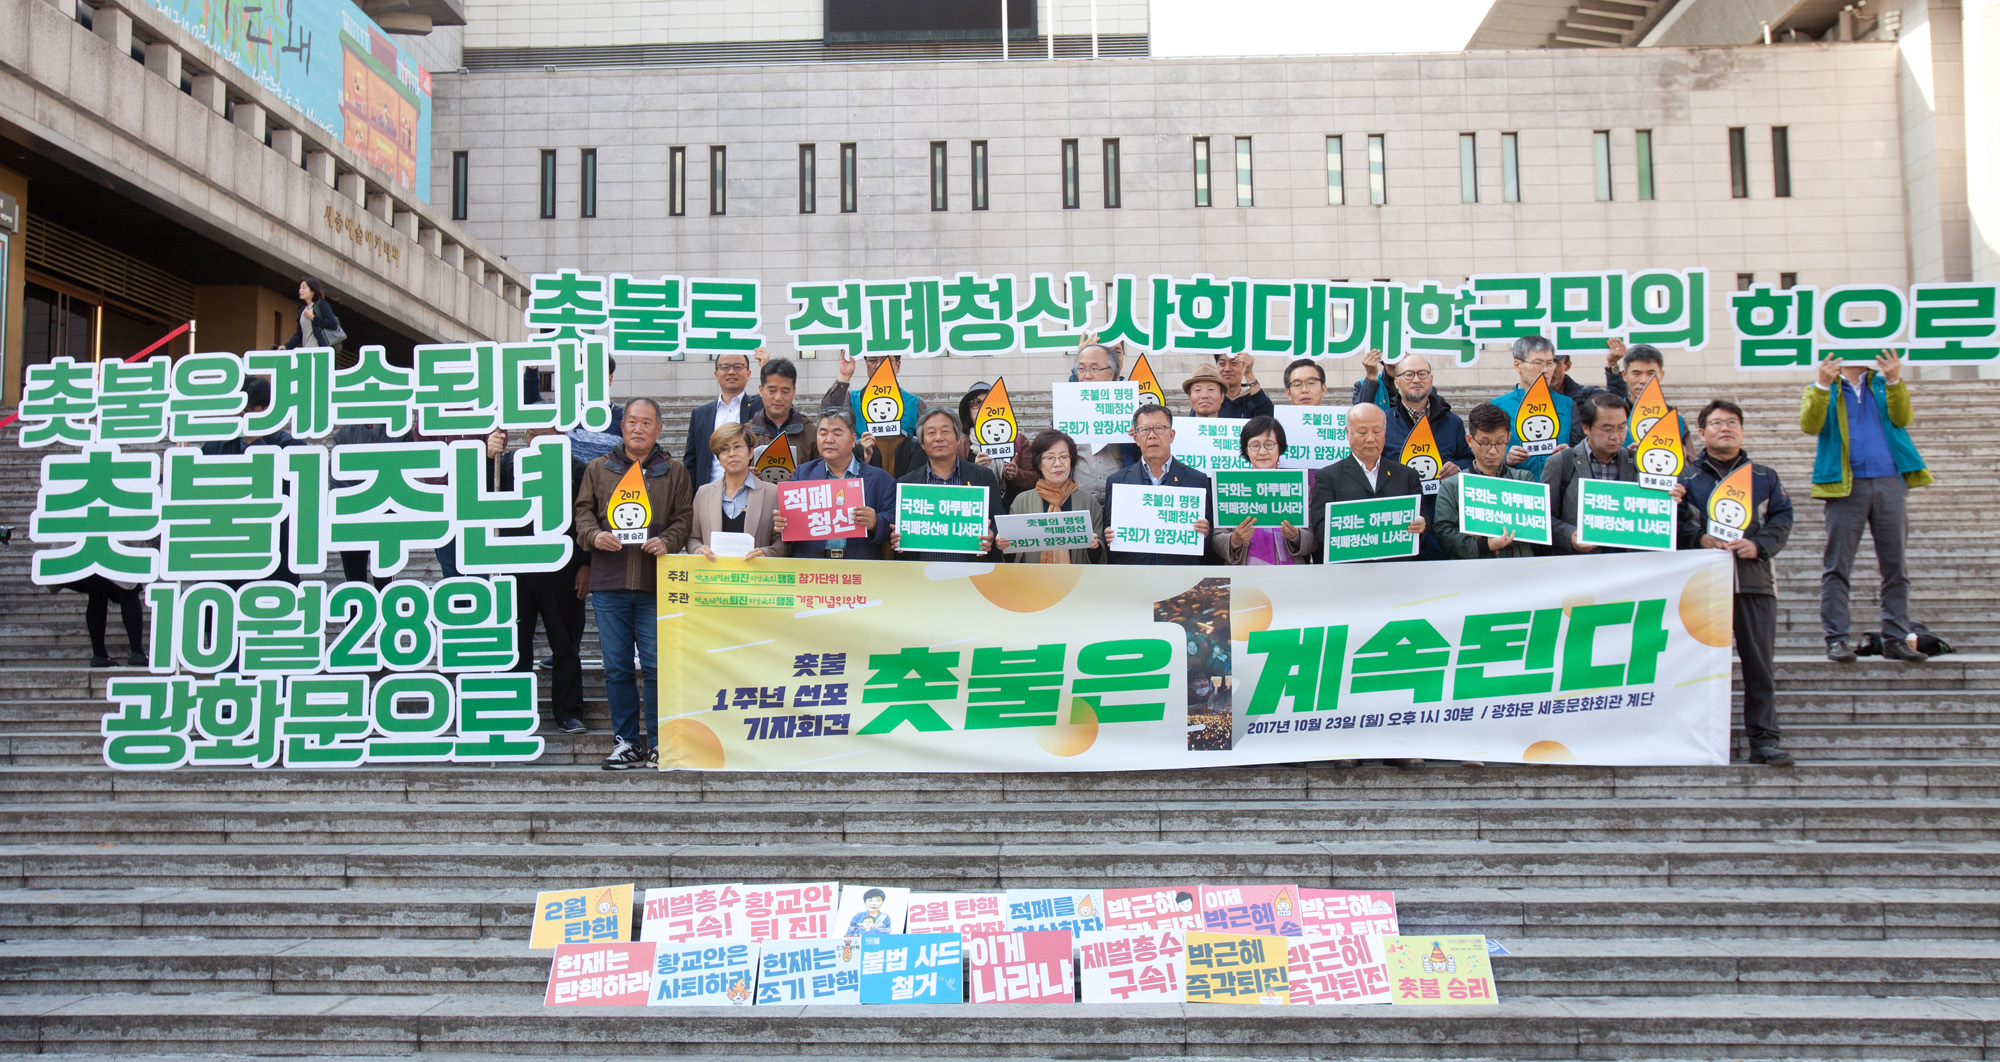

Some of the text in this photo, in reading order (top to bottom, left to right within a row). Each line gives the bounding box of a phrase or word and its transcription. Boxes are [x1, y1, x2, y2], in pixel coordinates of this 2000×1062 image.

[1732, 286, 1999, 366] 힘으로
[872, 385, 892, 395] 2017
[1080, 388, 1134, 401] 촛불의 명령
[1138, 381, 1151, 391] 017
[985, 407, 1006, 417] 2017
[1095, 402, 1134, 415] 적폐청산
[1526, 403, 1547, 414] 2017
[1640, 406, 1661, 416] 2017
[885, 425, 898, 433] 승리
[1058, 421, 1090, 435] 국회가
[1198, 424, 1243, 437] 촛불의 명
[1302, 413, 1346, 427] 촛불의 명
[1212, 438, 1242, 451] 적폐청
[1316, 427, 1346, 441] 적폐청
[1652, 436, 1674, 447] 2017
[999, 447, 1011, 455] 승리
[1410, 443, 1431, 454] 2017
[1541, 443, 1554, 451] 승리
[766, 456, 787, 465] 2017
[1217, 482, 1303, 497] 국회는 하루빨리
[1425, 483, 1437, 491] 승리
[1659, 479, 1673, 487] 승리
[1726, 485, 1746, 499] 2017
[619, 490, 641, 501] 2017
[783, 484, 833, 513] 적폐
[1142, 493, 1200, 509] 촛불의 명령
[1464, 486, 1545, 511] 국회는 하루빨리
[1584, 493, 1671, 515] 국회는 하루빨리
[901, 498, 983, 517] 국회는 하루빨리
[1157, 509, 1200, 524] 적폐청산
[1218, 501, 1303, 515] 적폐청산에 나서라
[1464, 506, 1547, 530] 적폐청산에 나서라
[901, 520, 983, 537] 적폐청산에 나서라
[1026, 516, 1085, 527] 촛불의 명령
[1043, 524, 1087, 534] 적폐청산
[1330, 509, 1414, 530] 국회는 하루빨리
[1583, 514, 1671, 536] 적폐청산에 나서라
[631, 532, 644, 540] 승리
[1008, 535, 1089, 548] 국회가 앞장서라
[1116, 527, 1199, 546] 국회가 앞장서라
[1330, 529, 1414, 549] 적폐청산에 나서라
[1726, 531, 1739, 541] 승리
[667, 570, 689, 582] 주최
[798, 572, 839, 585] 참가단위
[842, 573, 862, 585] 일동
[667, 592, 690, 604] 주관
[792, 652, 847, 677] 촛불
[855, 638, 1173, 736] 촛불은
[1245, 598, 1669, 717] 계속된다
[793, 683, 849, 708] 선포
[106, 676, 541, 765] 광화문으로
[1247, 719, 1290, 735] 2017년
[1294, 718, 1322, 732] 10월
[1325, 715, 1356, 730] 23일
[1359, 713, 1384, 728] (월)
[1387, 711, 1417, 727] 오후
[1420, 709, 1440, 724] 1시
[1443, 706, 1474, 722] 30분
[1491, 701, 1534, 719] 광화문
[1537, 695, 1623, 715] 세종문화회관
[1626, 692, 1655, 708] 계단
[743, 713, 851, 740] 기자회견
[545, 896, 587, 921] 2월
[645, 886, 741, 920] 재벌총수
[745, 885, 833, 918] 황교안
[1009, 896, 1075, 921] 적폐를
[1106, 890, 1181, 920] 박근혜
[1205, 888, 1244, 909] 이제
[1300, 894, 1373, 921] 박근혜
[909, 901, 949, 923] 2월
[954, 896, 1000, 920] 탄핵
[1204, 902, 1276, 930] 박근혜
[564, 914, 619, 943] 탄핵
[668, 912, 733, 943] 구속!
[657, 944, 748, 975] 황교안은
[862, 941, 960, 975] 불법 사드
[971, 932, 1026, 967] 이게
[1081, 931, 1183, 970] 재벌총수
[1188, 938, 1265, 968] 박근혜
[1288, 934, 1373, 975] 박근혜
[556, 949, 630, 979] 헌재는
[763, 947, 837, 977] 헌재는
[554, 970, 652, 1004] 탄핵하라
[657, 969, 753, 1001] 사퇴하라
[758, 969, 859, 1004] 조기 탄핵
[891, 972, 938, 1001] 철거
[972, 958, 1073, 1004] 나라냐
[1108, 963, 1178, 1000] 구속!
[1186, 966, 1290, 999] 즉각퇴진
[1289, 963, 1390, 1005] 즉각퇴진
[1398, 976, 1490, 999] 촛불 승리
